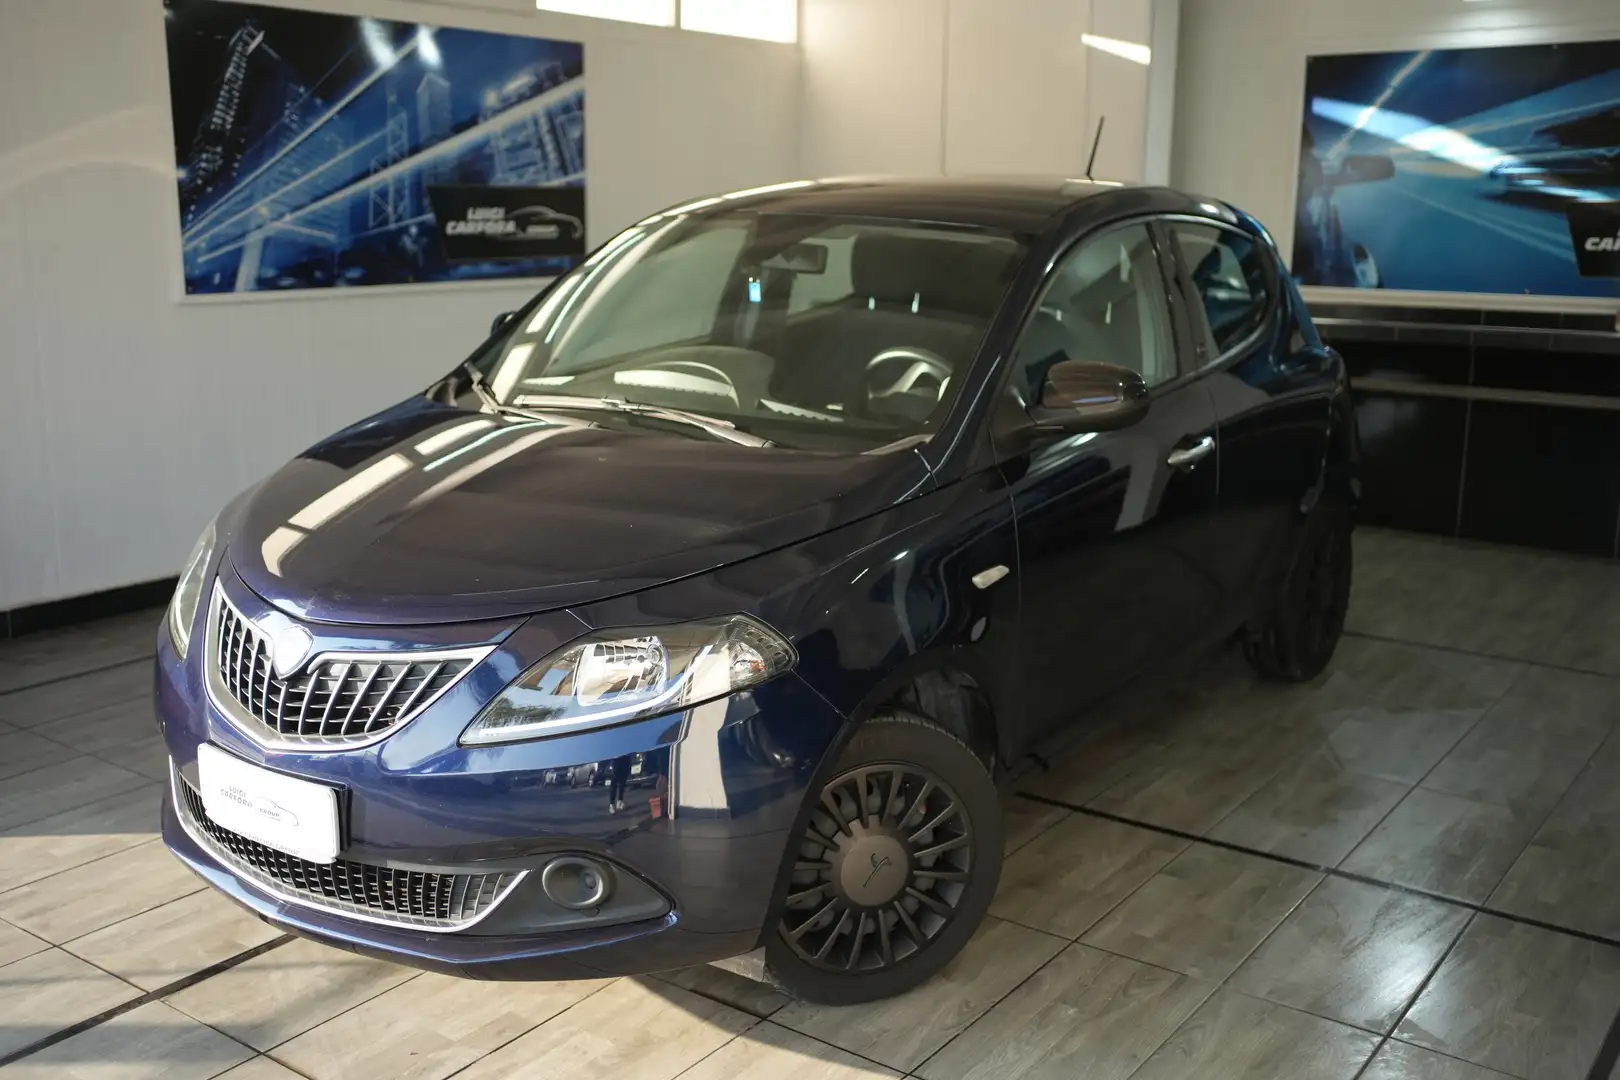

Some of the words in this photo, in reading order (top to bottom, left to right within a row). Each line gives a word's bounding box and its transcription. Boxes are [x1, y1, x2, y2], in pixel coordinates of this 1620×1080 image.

[466, 206, 506, 221] LUIGI
[445, 220, 517, 236] CARFORA
[220, 788, 253, 808] CARFORA
[228, 785, 247, 798] LUIGI
